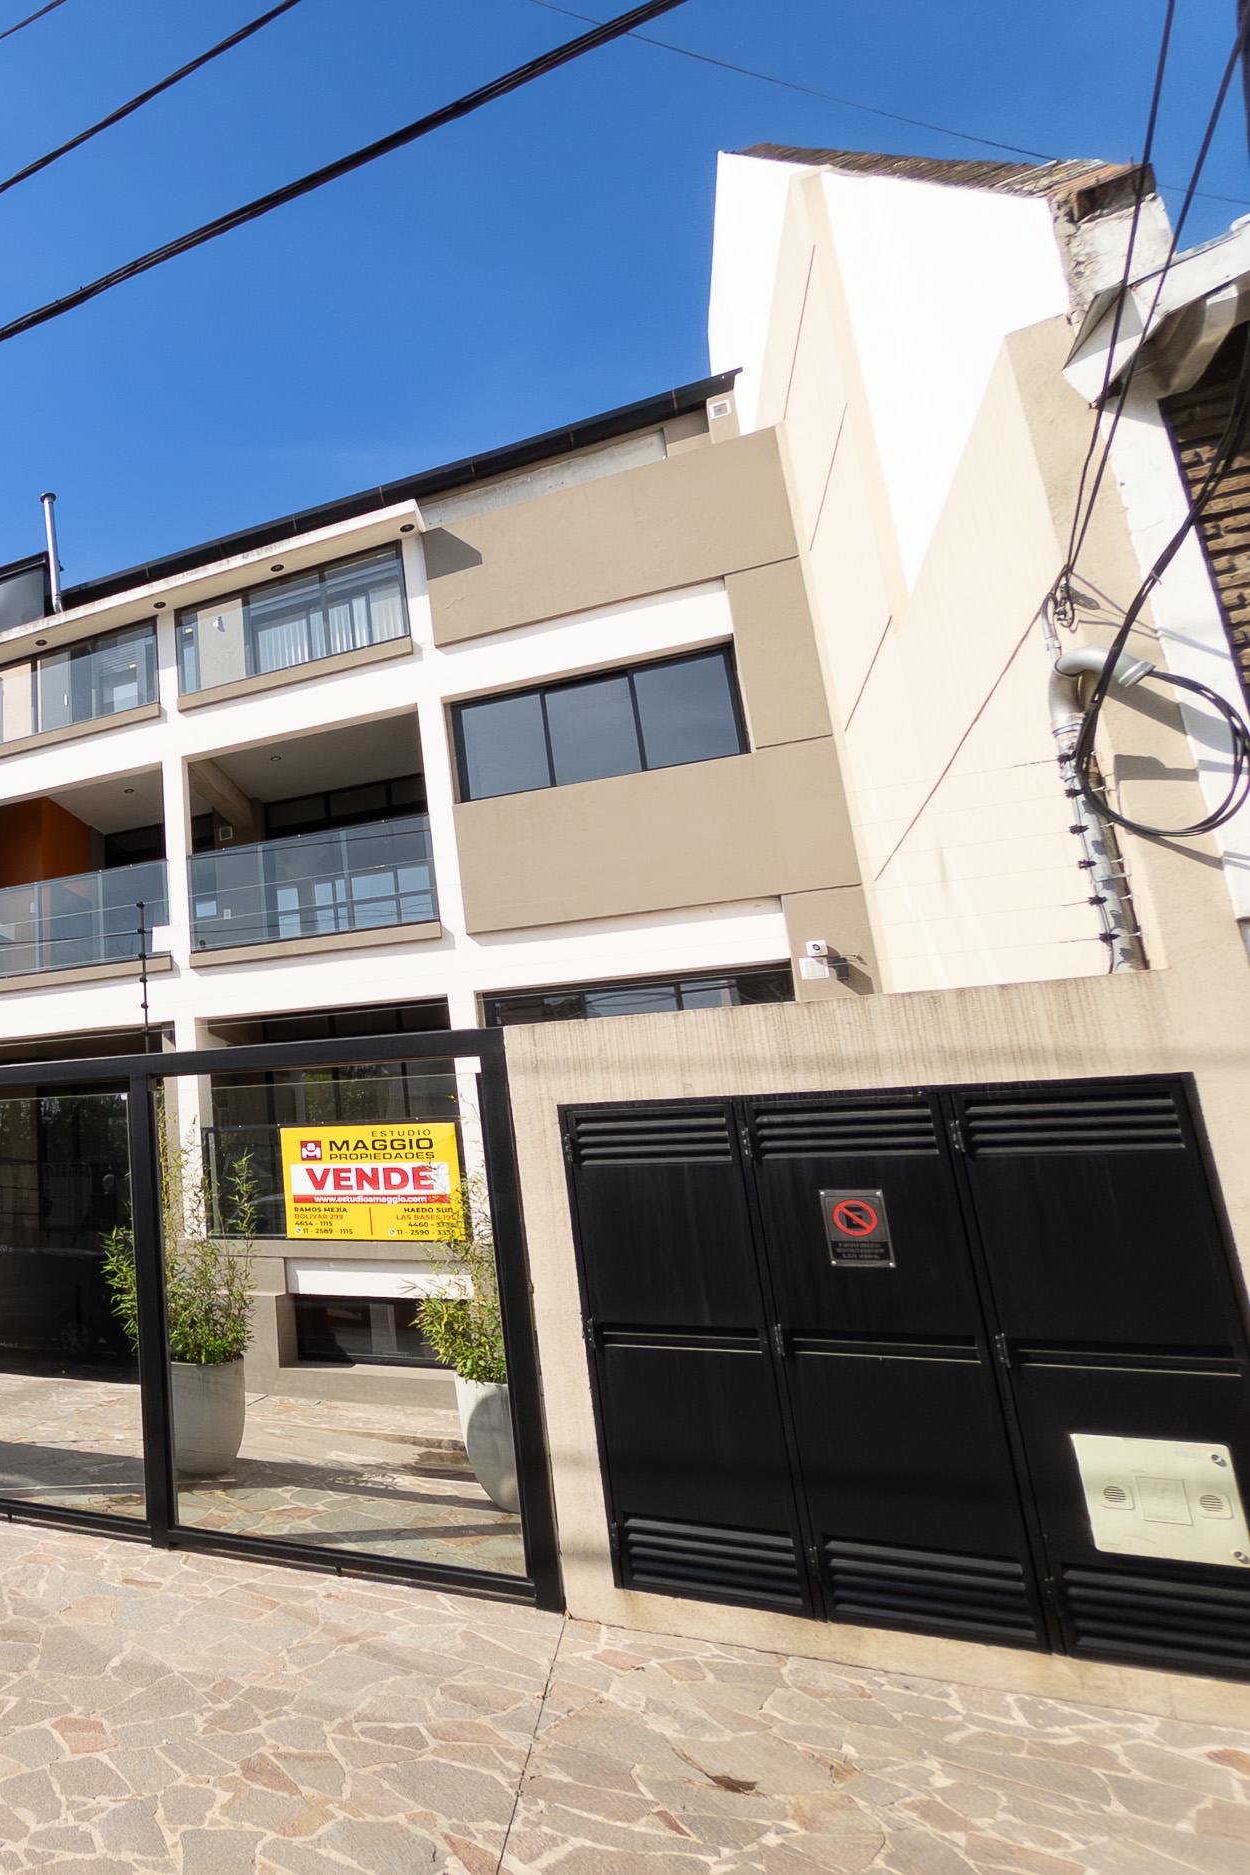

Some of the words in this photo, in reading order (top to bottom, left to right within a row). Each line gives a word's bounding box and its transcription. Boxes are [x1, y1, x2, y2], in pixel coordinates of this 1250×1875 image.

[371, 1128, 432, 1138] ESTUDIO
[329, 1137, 434, 1152] MAGGIO
[329, 1151, 435, 1161] PROPIEDADES
[305, 1165, 434, 1191] VENDE
[313, 1194, 427, 1205] www.estudioamaggio.com
